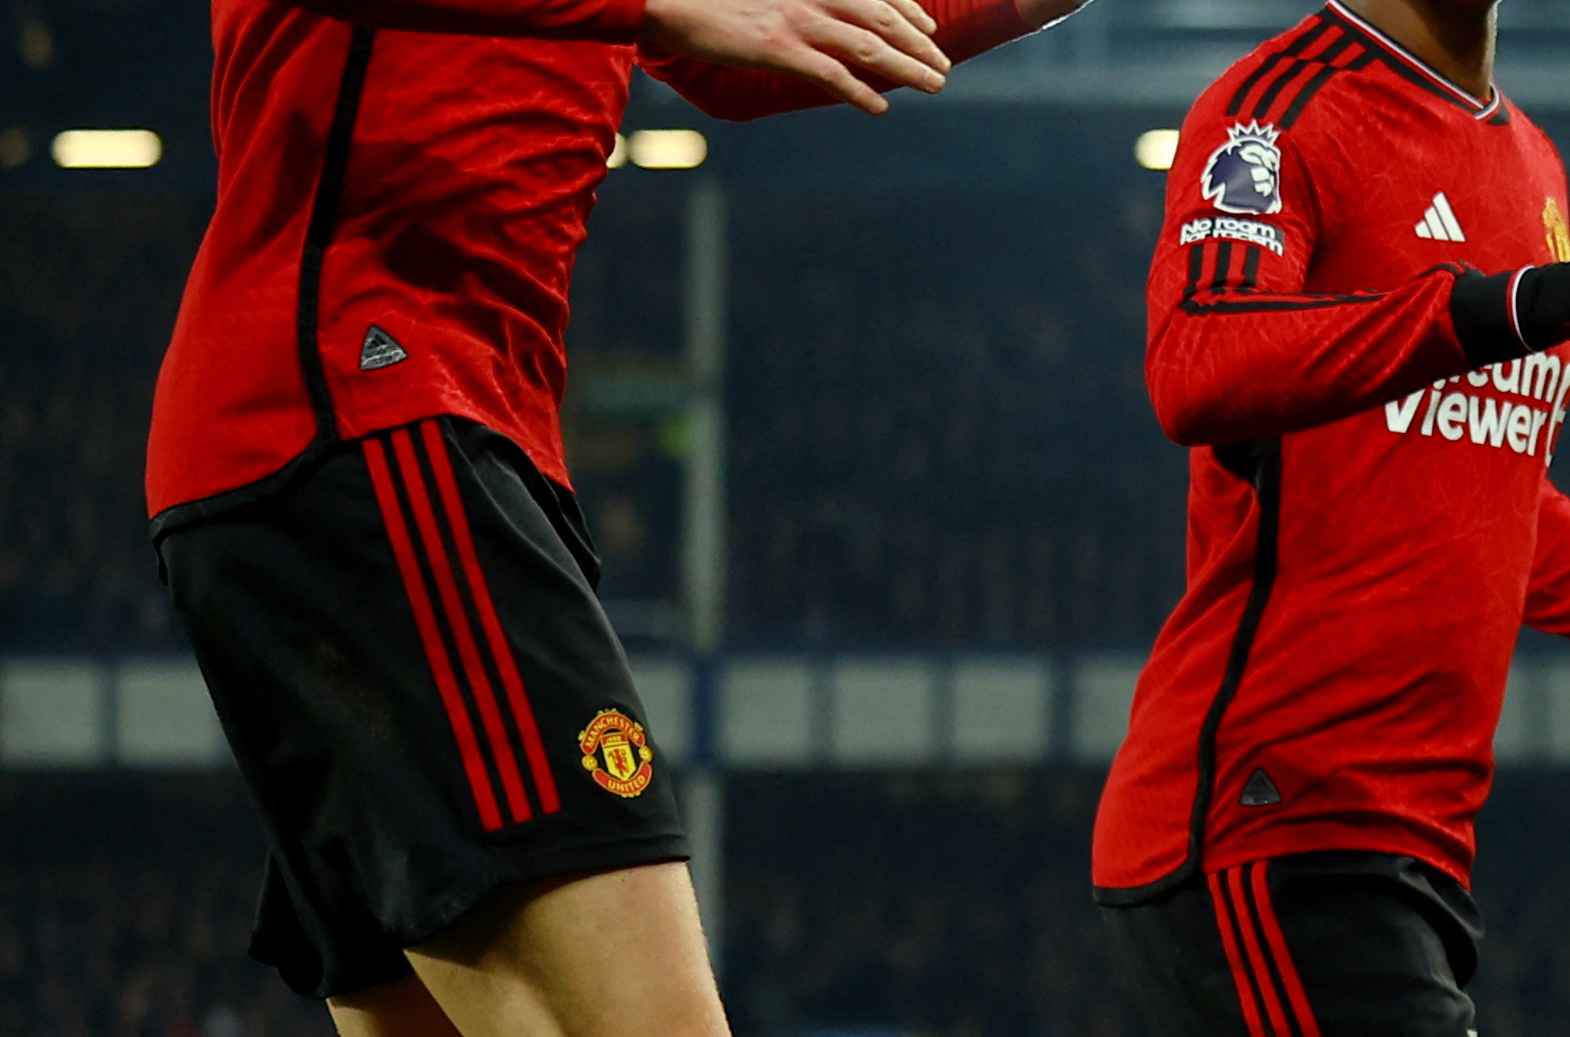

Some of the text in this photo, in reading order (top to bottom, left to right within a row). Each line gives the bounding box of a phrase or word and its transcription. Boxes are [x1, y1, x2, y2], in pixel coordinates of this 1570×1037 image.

[1180, 217, 1276, 240] No room
[1385, 378, 1547, 456] Viewer
[607, 774, 646, 793] UNITED
